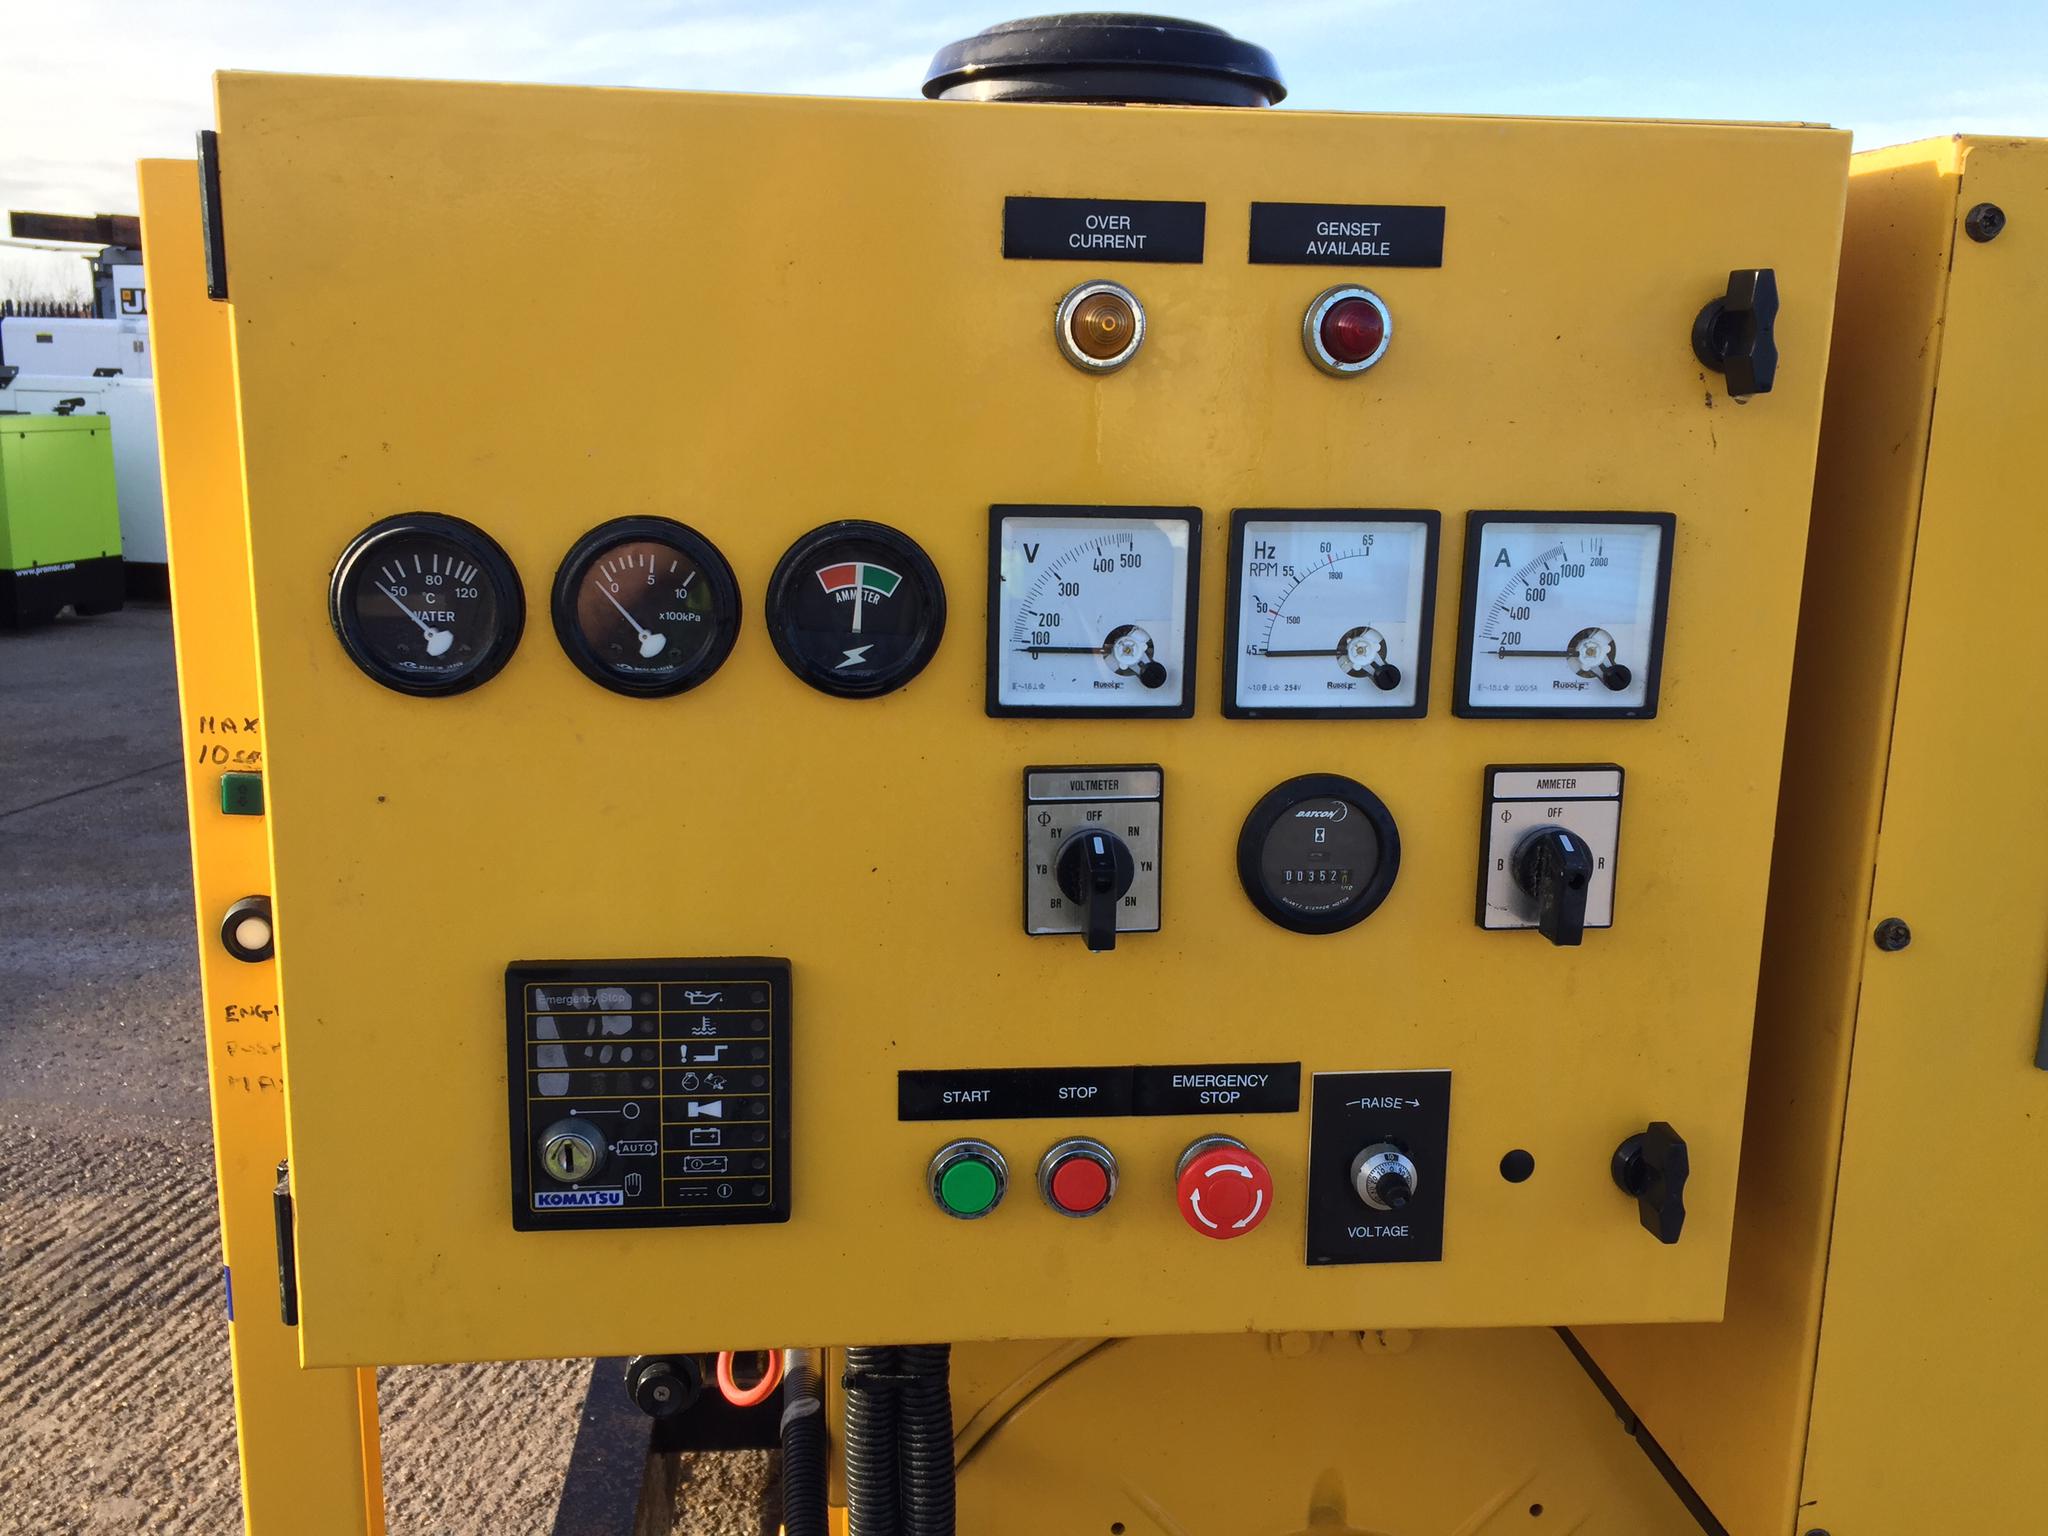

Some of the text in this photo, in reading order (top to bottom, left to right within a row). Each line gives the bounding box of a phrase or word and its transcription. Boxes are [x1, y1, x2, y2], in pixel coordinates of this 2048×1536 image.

[1086, 215, 1131, 230] OVER
[1316, 222, 1381, 237] GENSET
[1069, 233, 1147, 249] CURRENT
[1306, 242, 1390, 256] AVAILABLE
[123, 290, 146, 312] J
[1362, 534, 1374, 546] 65
[1023, 543, 1040, 563] V
[1254, 541, 1276, 559] Hz
[1320, 542, 1331, 553] 60
[1120, 554, 1142, 568] 500
[1494, 548, 1511, 567] A
[1590, 558, 1608, 567] 2000
[1093, 559, 1114, 573] 400
[1250, 563, 1278, 576] RPM
[1282, 565, 1294, 577] 55
[1560, 564, 1585, 578] 1000
[425, 575, 443, 586] 80
[647, 575, 655, 585] 5
[1328, 571, 1343, 580] 1800
[1539, 572, 1560, 586] 800
[390, 586, 407, 596] 50
[455, 588, 478, 598] 120
[610, 583, 619, 593] 0
[674, 588, 688, 599] 10
[1058, 582, 1080, 597] 300
[835, 589, 881, 605] AMMTER
[1525, 588, 1546, 602] 600
[1256, 602, 1267, 613] 50
[1509, 606, 1530, 620] 400
[411, 611, 455, 622] WATER
[659, 611, 701, 622] x100kPa
[1038, 613, 1060, 627] 200
[1286, 616, 1300, 625] 1500
[1031, 631, 1050, 645] 100
[1501, 631, 1521, 645] 200
[1246, 645, 1257, 655] 45
[1070, 780, 1119, 791] VOLTMETER
[1537, 779, 1577, 789] AMMETER
[1086, 811, 1102, 821] OFF
[1296, 810, 1338, 820] DATCON
[1547, 808, 1563, 818] OFF
[1051, 828, 1062, 839] RY
[1128, 826, 1140, 837] RN
[1141, 861, 1152, 871] YN
[1497, 859, 1504, 871] B
[1598, 857, 1605, 869] R
[1036, 864, 1047, 875] YB
[1051, 899, 1062, 909] BR
[1125, 896, 1136, 907] BN
[541, 993, 598, 1005] mergency
[1172, 1074, 1269, 1088] EMERGENCY
[943, 1090, 990, 1103] START
[1058, 1086, 1098, 1099] STOP
[1200, 1091, 1240, 1104] STOP
[1361, 1097, 1403, 1109] RAISE
[622, 1144, 652, 1152] AUTO
[538, 1192, 620, 1206] KOMATSU
[1348, 1226, 1409, 1238] VOLTAGE
